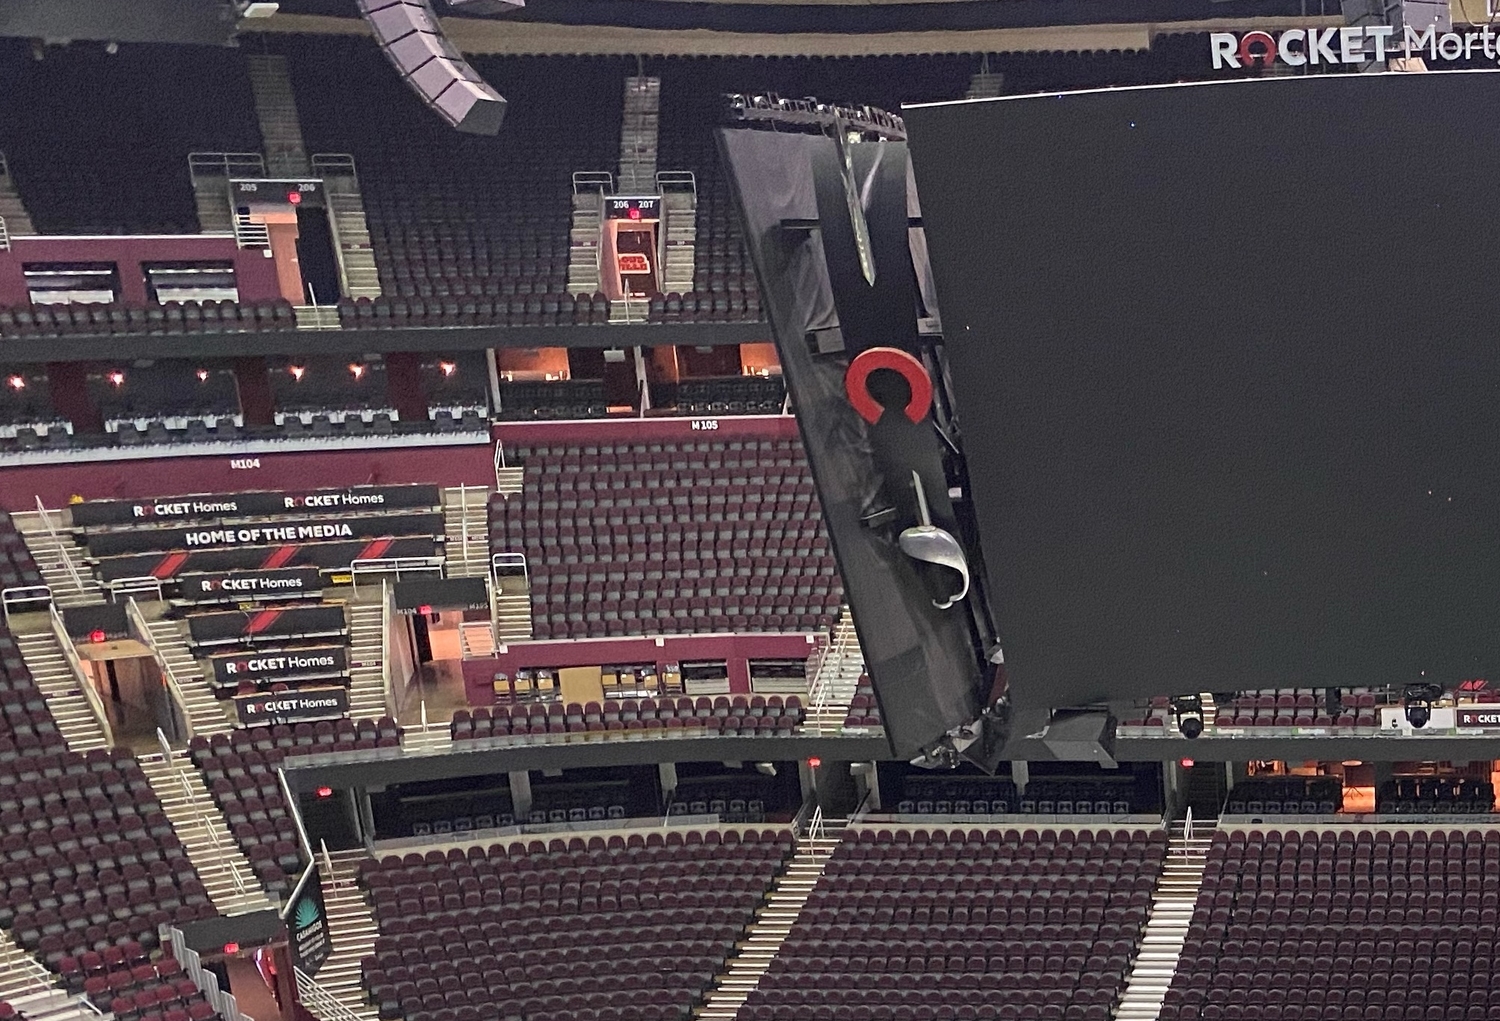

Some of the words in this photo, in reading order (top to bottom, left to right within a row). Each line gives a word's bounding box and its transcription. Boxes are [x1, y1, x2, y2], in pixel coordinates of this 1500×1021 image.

[1210, 25, 1393, 69] ROCKET
[613, 200, 629, 208] 206
[638, 200, 654, 208] 207
[231, 459, 260, 469] M104
[133, 502, 191, 518] ROCKET
[192, 500, 238, 515] Homes
[284, 494, 341, 509] ROCKET
[342, 493, 385, 506] Homes
[185, 530, 236, 546] HOME
[238, 526, 261, 543] OF
[262, 525, 298, 541] THE
[298, 523, 353, 540] MEDIA
[201, 578, 258, 592] ROCKET
[260, 577, 303, 589] Homes
[226, 657, 286, 674] ROCKET
[287, 655, 334, 669] Homes
[246, 698, 298, 714] ROCKET
[299, 697, 338, 710] Homes
